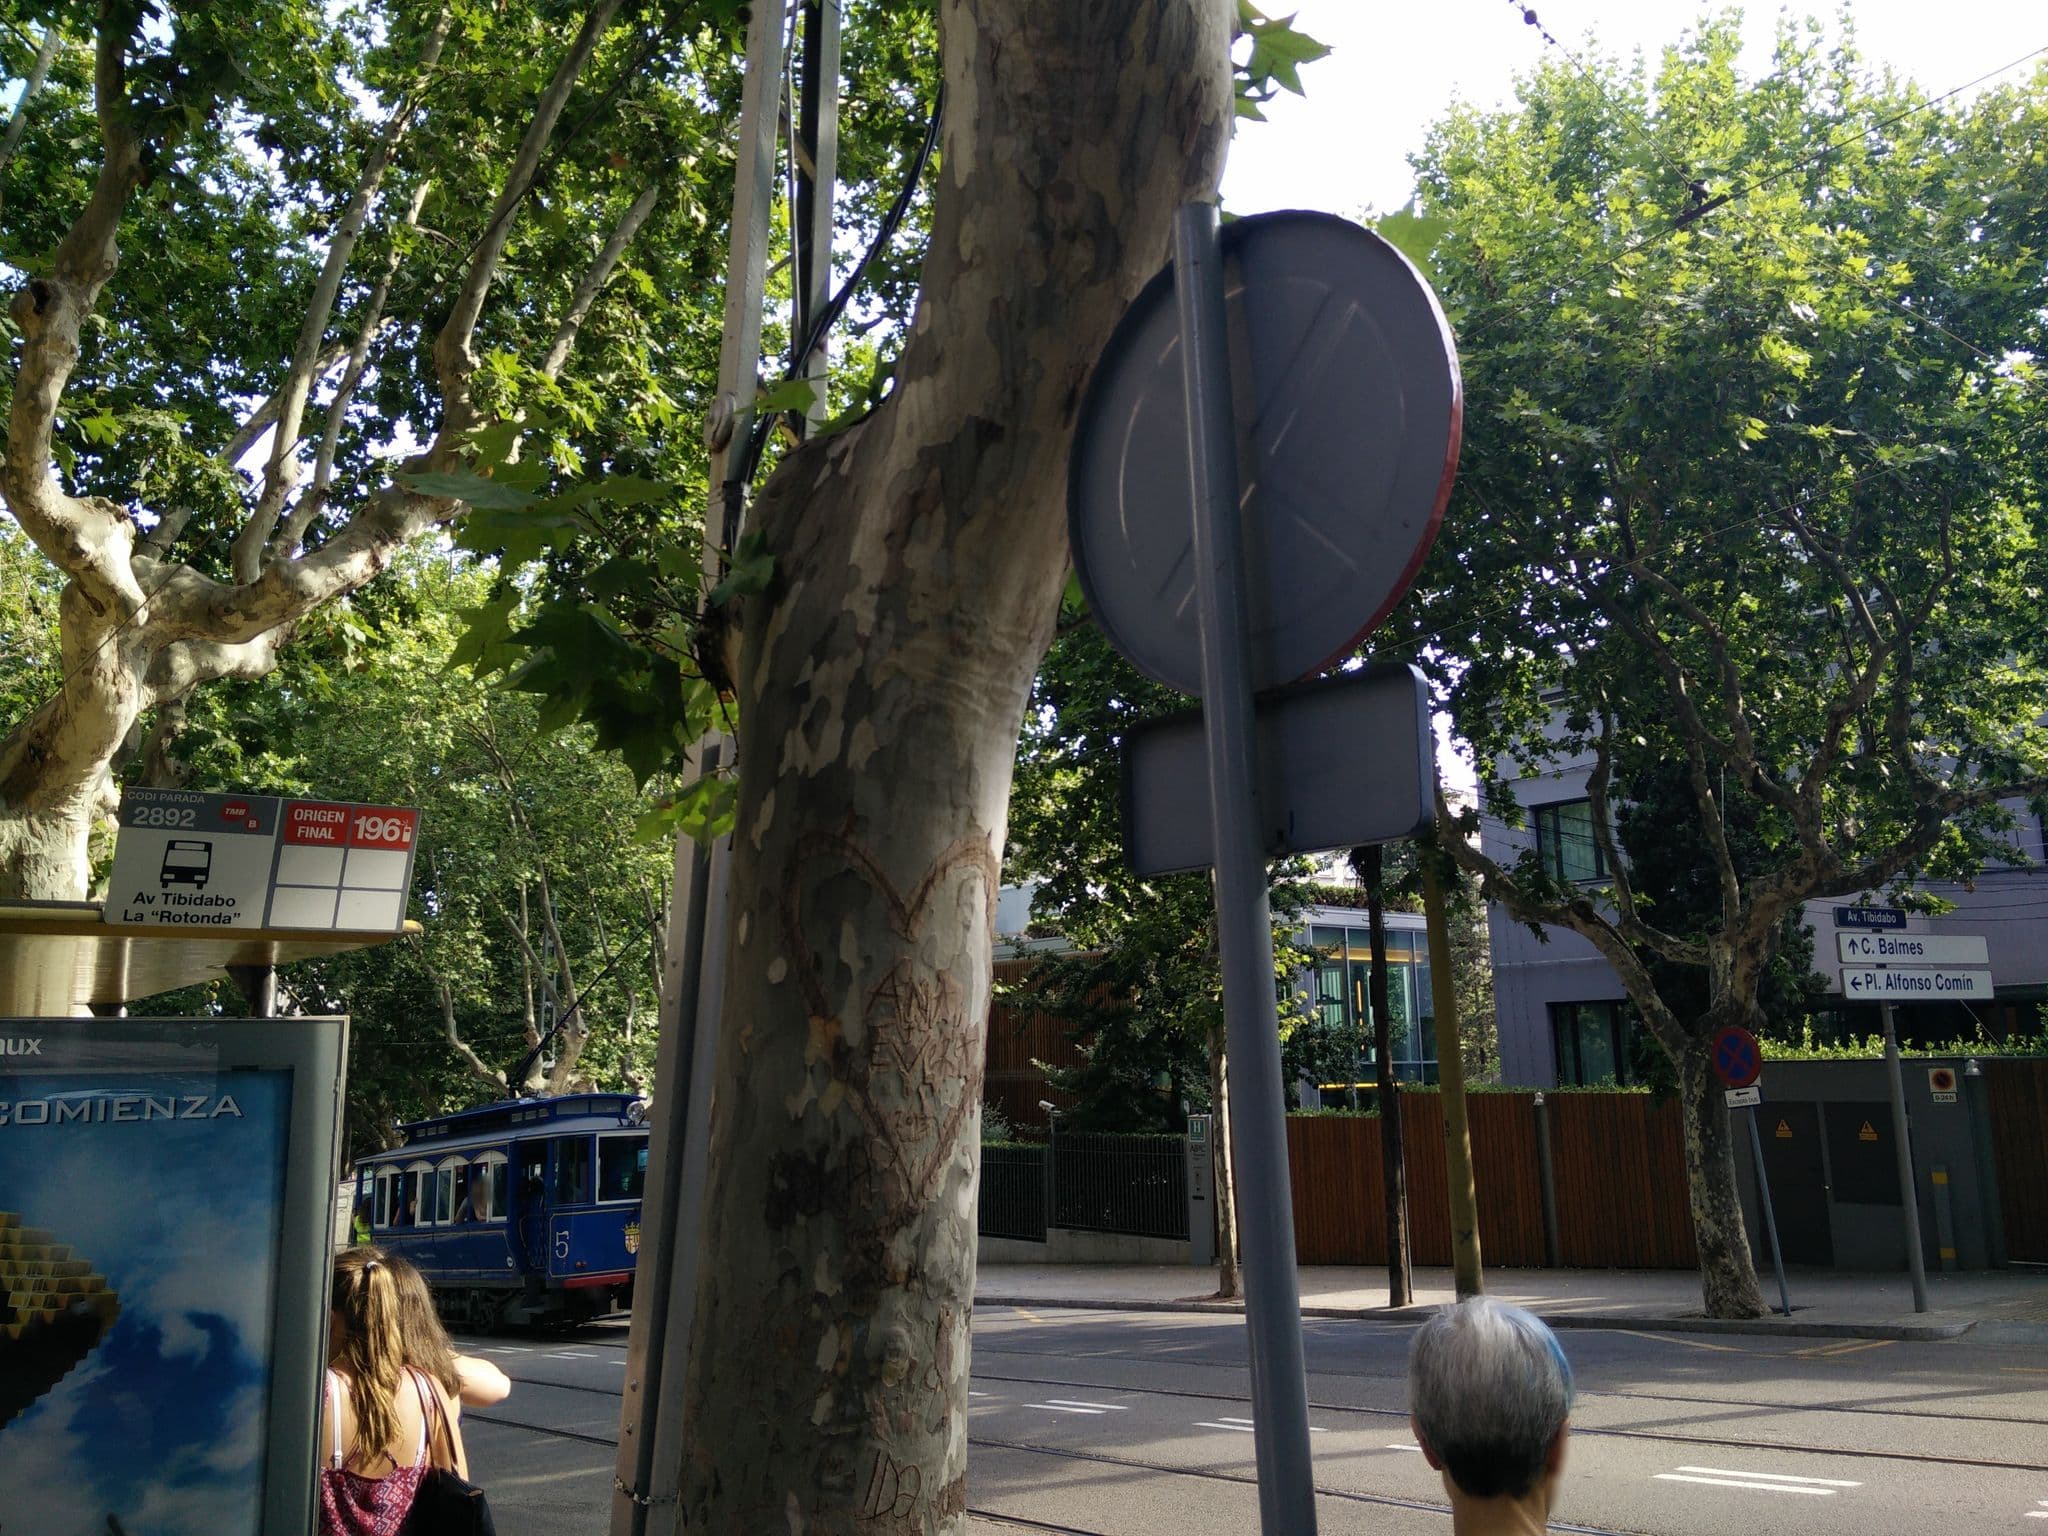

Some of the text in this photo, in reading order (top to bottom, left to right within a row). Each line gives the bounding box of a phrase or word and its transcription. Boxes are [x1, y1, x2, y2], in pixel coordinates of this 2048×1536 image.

[127, 791, 206, 804] CODI PARADA
[133, 806, 197, 828] 2892
[294, 808, 401, 842] ORIGEN 196
[296, 826, 336, 840] FINAL
[132, 891, 236, 907] Av Tibidabo
[122, 909, 145, 922] La
[1847, 911, 1897, 924] Av. Tibidabo
[1861, 937, 1924, 956] C. Balmes
[1865, 973, 1974, 991] Pl. Alfonso Comín
[555, 1230, 570, 1258] 5
